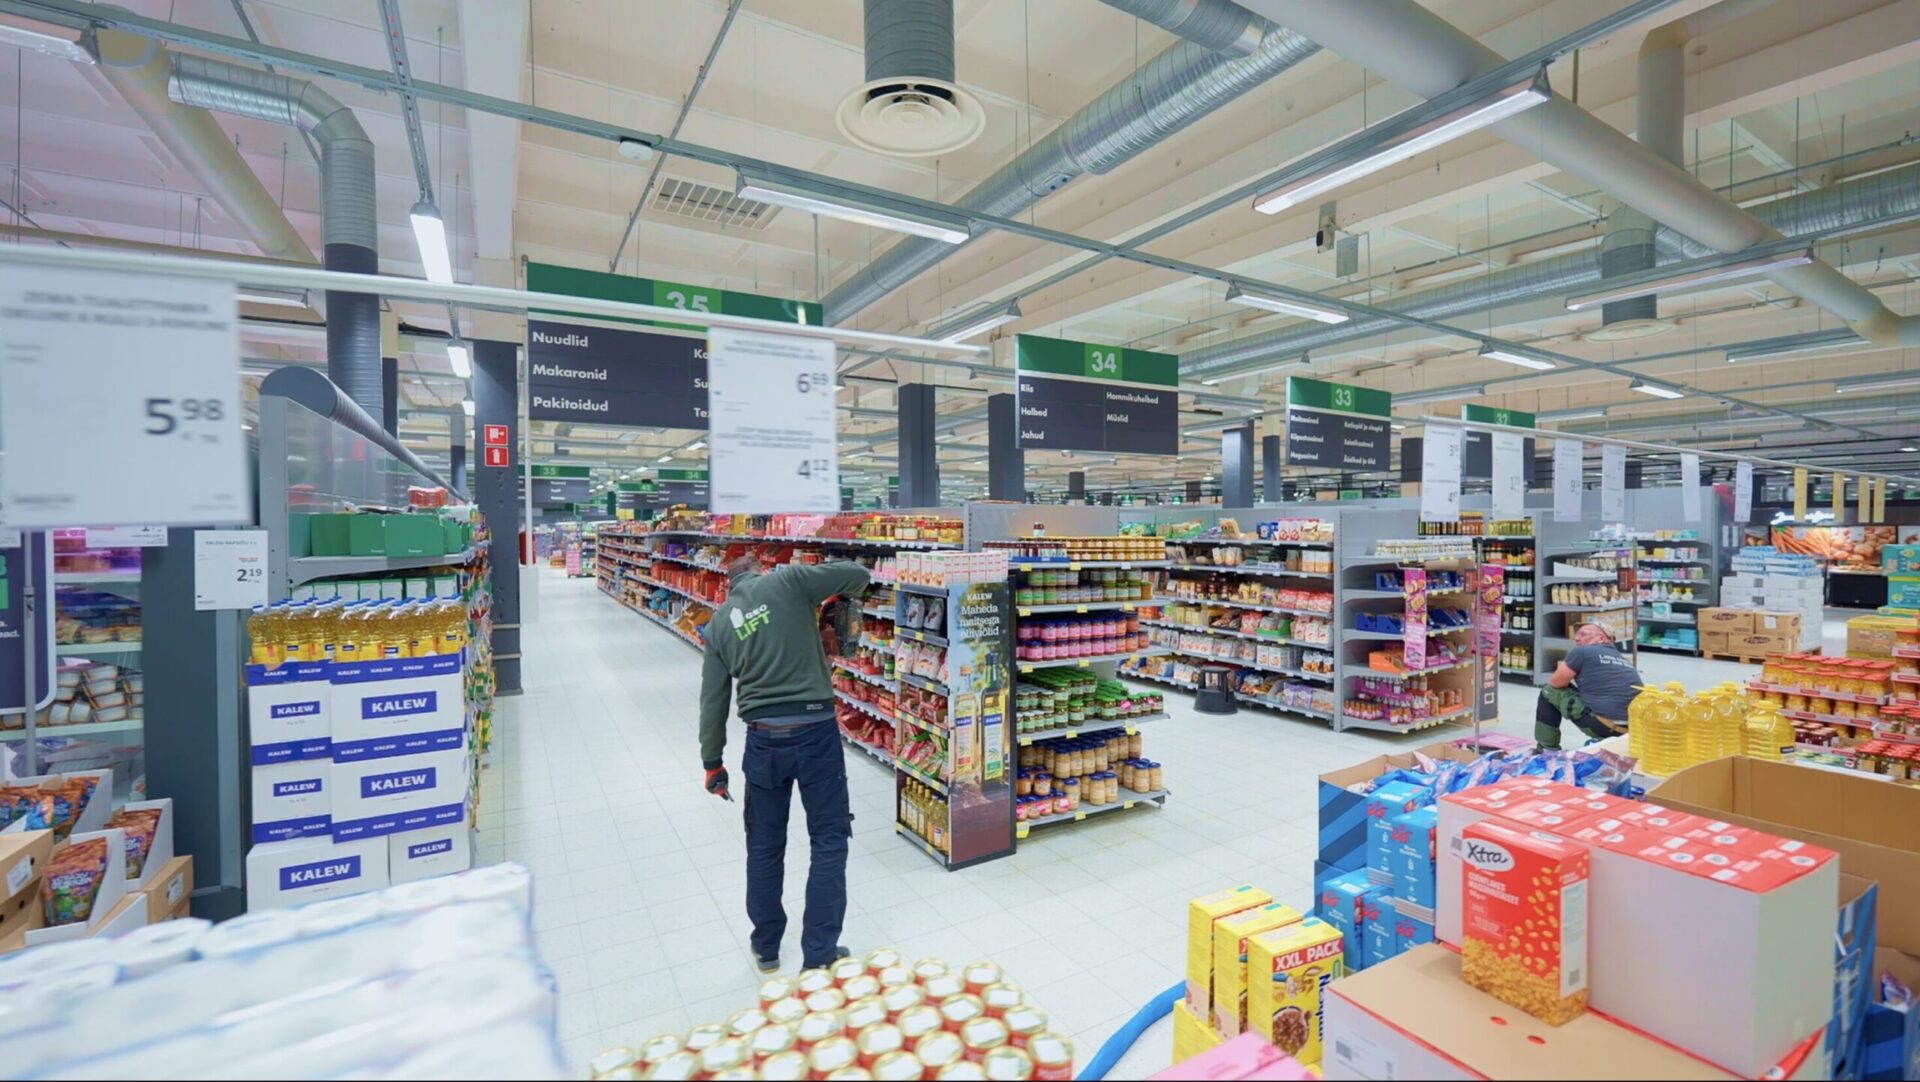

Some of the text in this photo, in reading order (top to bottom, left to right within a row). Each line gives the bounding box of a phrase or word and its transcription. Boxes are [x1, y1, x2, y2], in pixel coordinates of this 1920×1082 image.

[666, 291, 709, 313] 35
[532, 331, 589, 348] Nuudlid
[693, 348, 709, 361] Ka
[1091, 351, 1117, 373] 34
[532, 363, 607, 381] Makaronid
[693, 378, 709, 389] Su
[1020, 384, 1034, 393] Riis
[533, 396, 609, 413] Pakitoidud
[1335, 388, 1352, 406] 33
[145, 398, 225, 434] 598
[1020, 407, 1048, 418] Helbed
[1020, 430, 1045, 440] Jahud
[236, 567, 262, 582] 219
[744, 604, 768, 620] GEO
[961, 604, 999, 615] Maheda
[735, 610, 770, 641] LIFT
[277, 705, 315, 716] KALEW
[371, 698, 428, 714] KALEW
[279, 782, 317, 794] KALEW
[371, 774, 428, 792] KALEW
[373, 822, 396, 830] KALEW
[405, 817, 427, 825] KALEW
[414, 842, 447, 855] KALEW
[1467, 842, 1508, 864] Xtra
[290, 862, 351, 884] KALEW
[1275, 939, 1341, 973] XXL PACK
